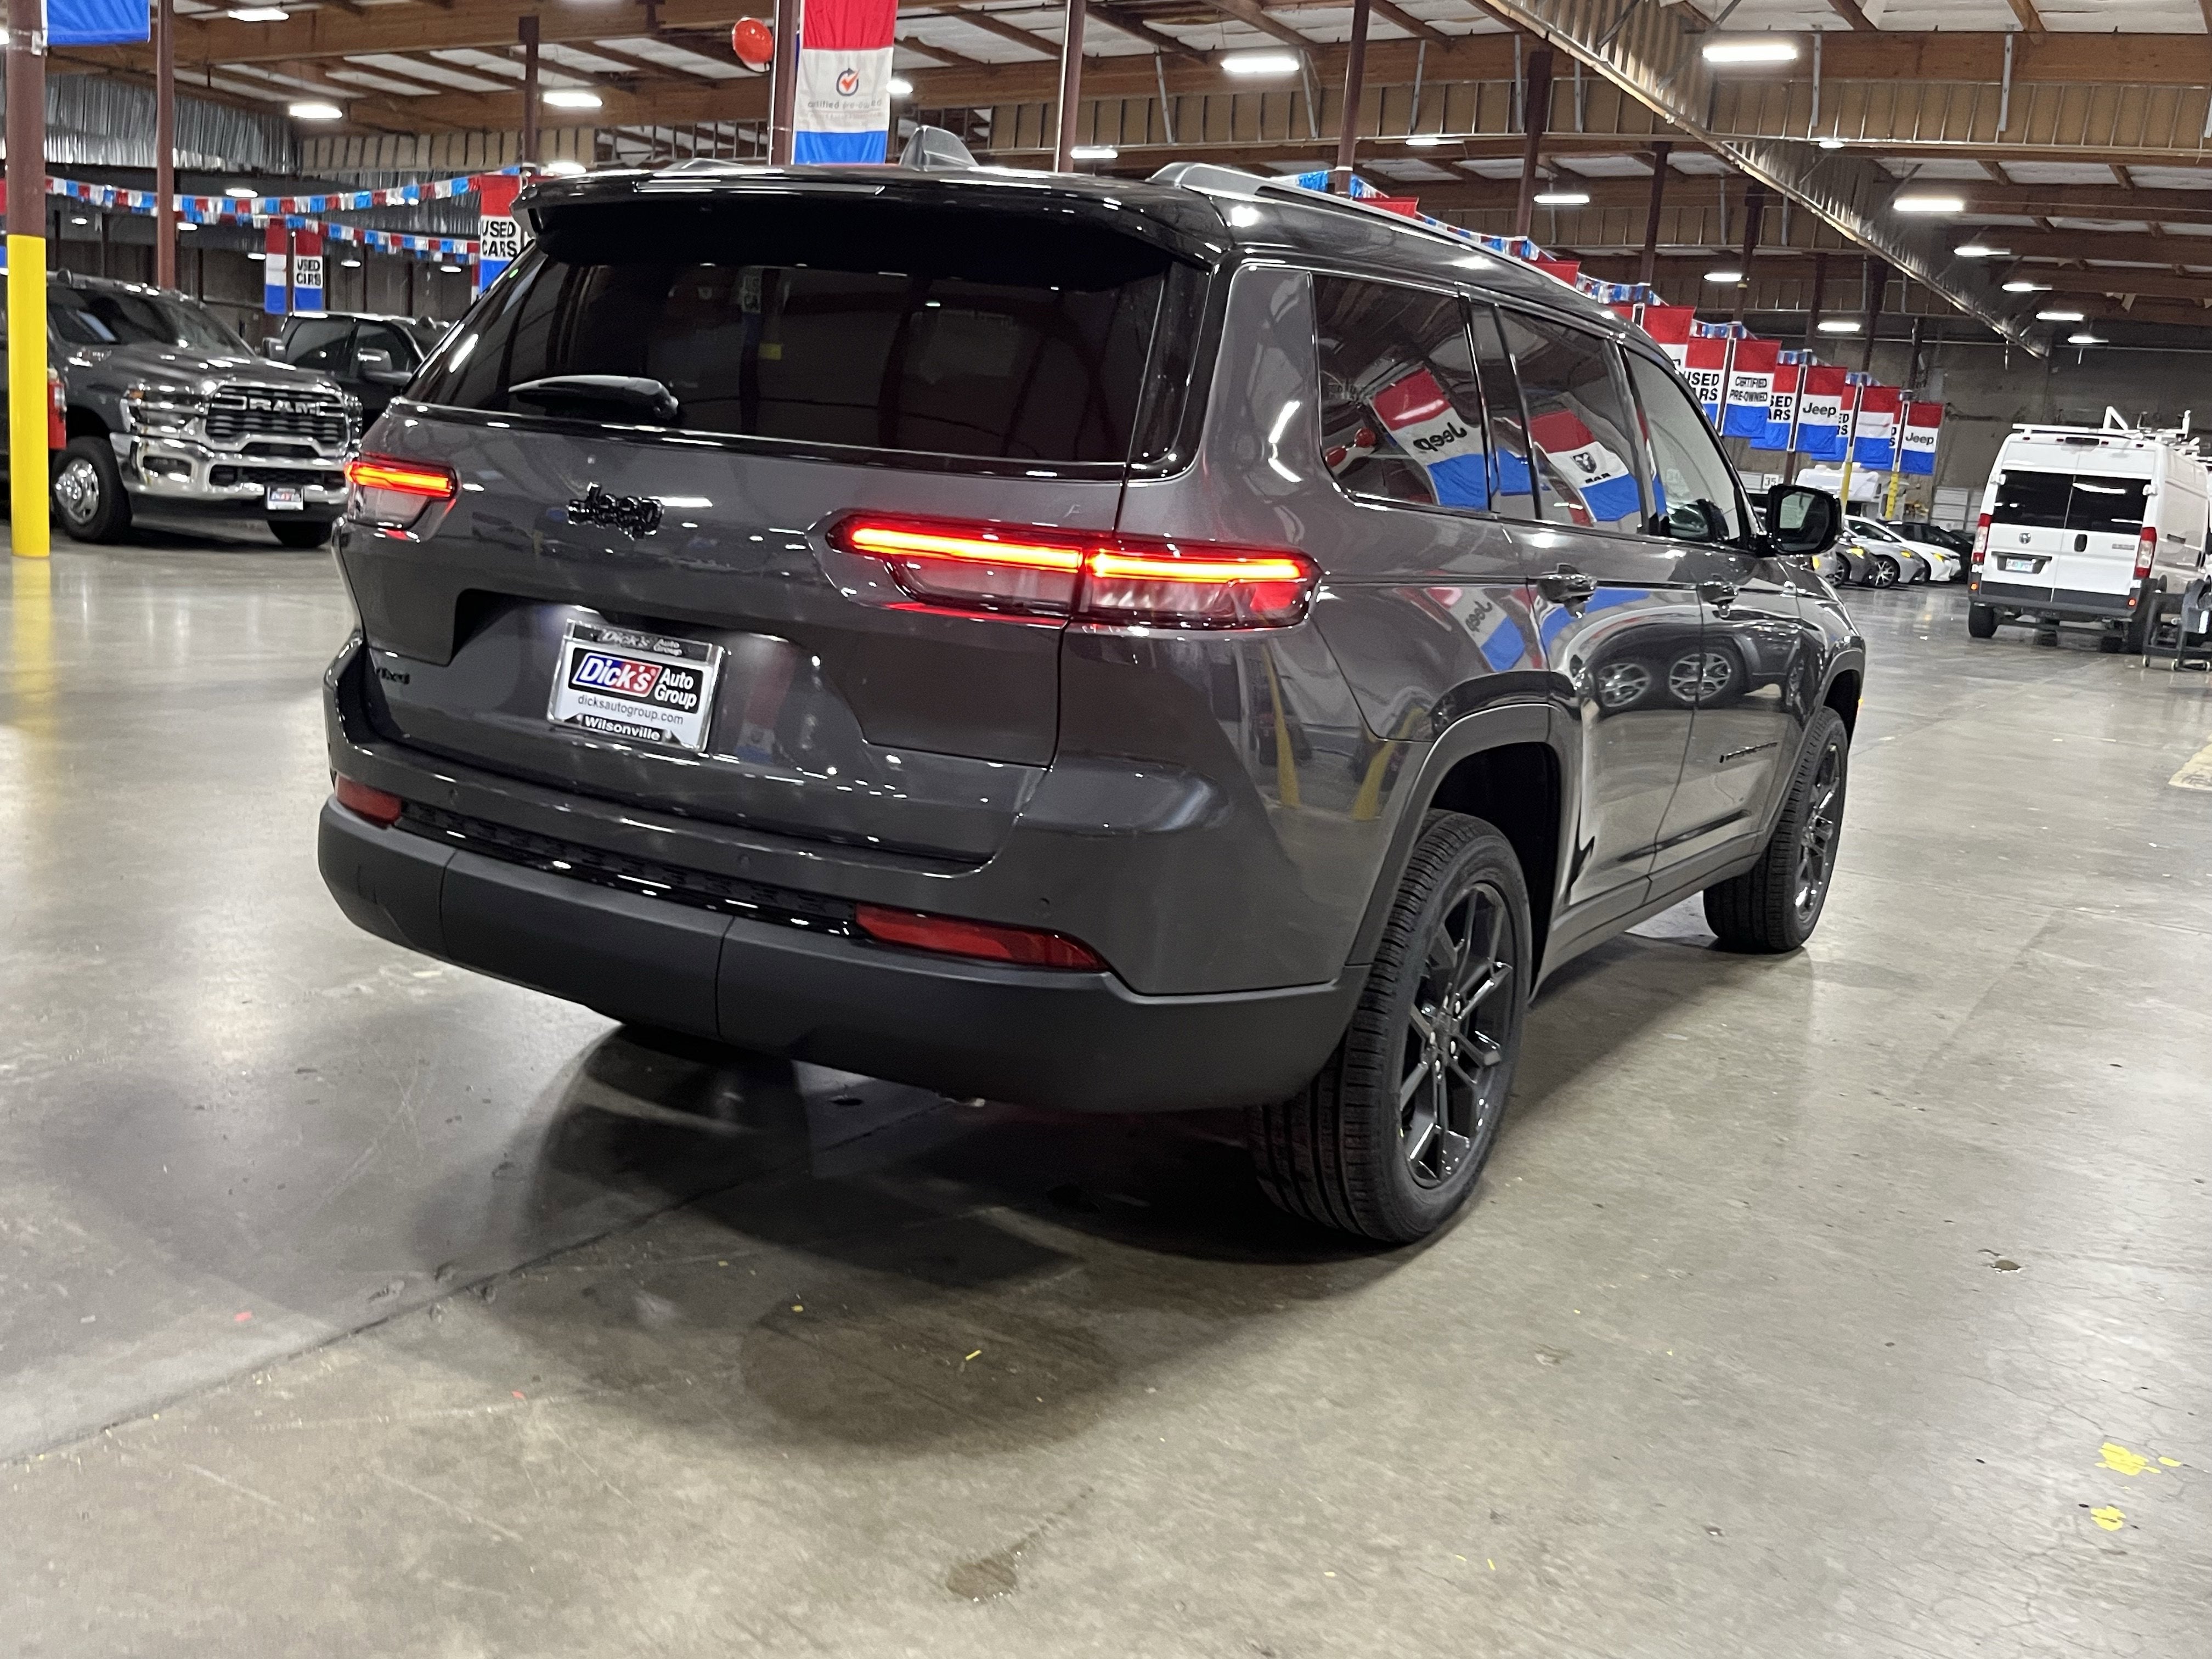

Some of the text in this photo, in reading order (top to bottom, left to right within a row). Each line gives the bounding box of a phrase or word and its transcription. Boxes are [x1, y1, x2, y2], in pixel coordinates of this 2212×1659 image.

[843, 100, 882, 109] pre-owed
[482, 240, 517, 257] CARS
[1735, 376, 1767, 388] CERTIFIED
[1729, 390, 1768, 402] PRE-OWNED
[1802, 402, 1837, 418] Jeep
[1905, 432, 1934, 445] Jeep
[659, 668, 695, 690] Auto
[653, 685, 697, 709] Group
[578, 694, 684, 725] dicksautogroup.com
[584, 715, 661, 741] Wilsonville
